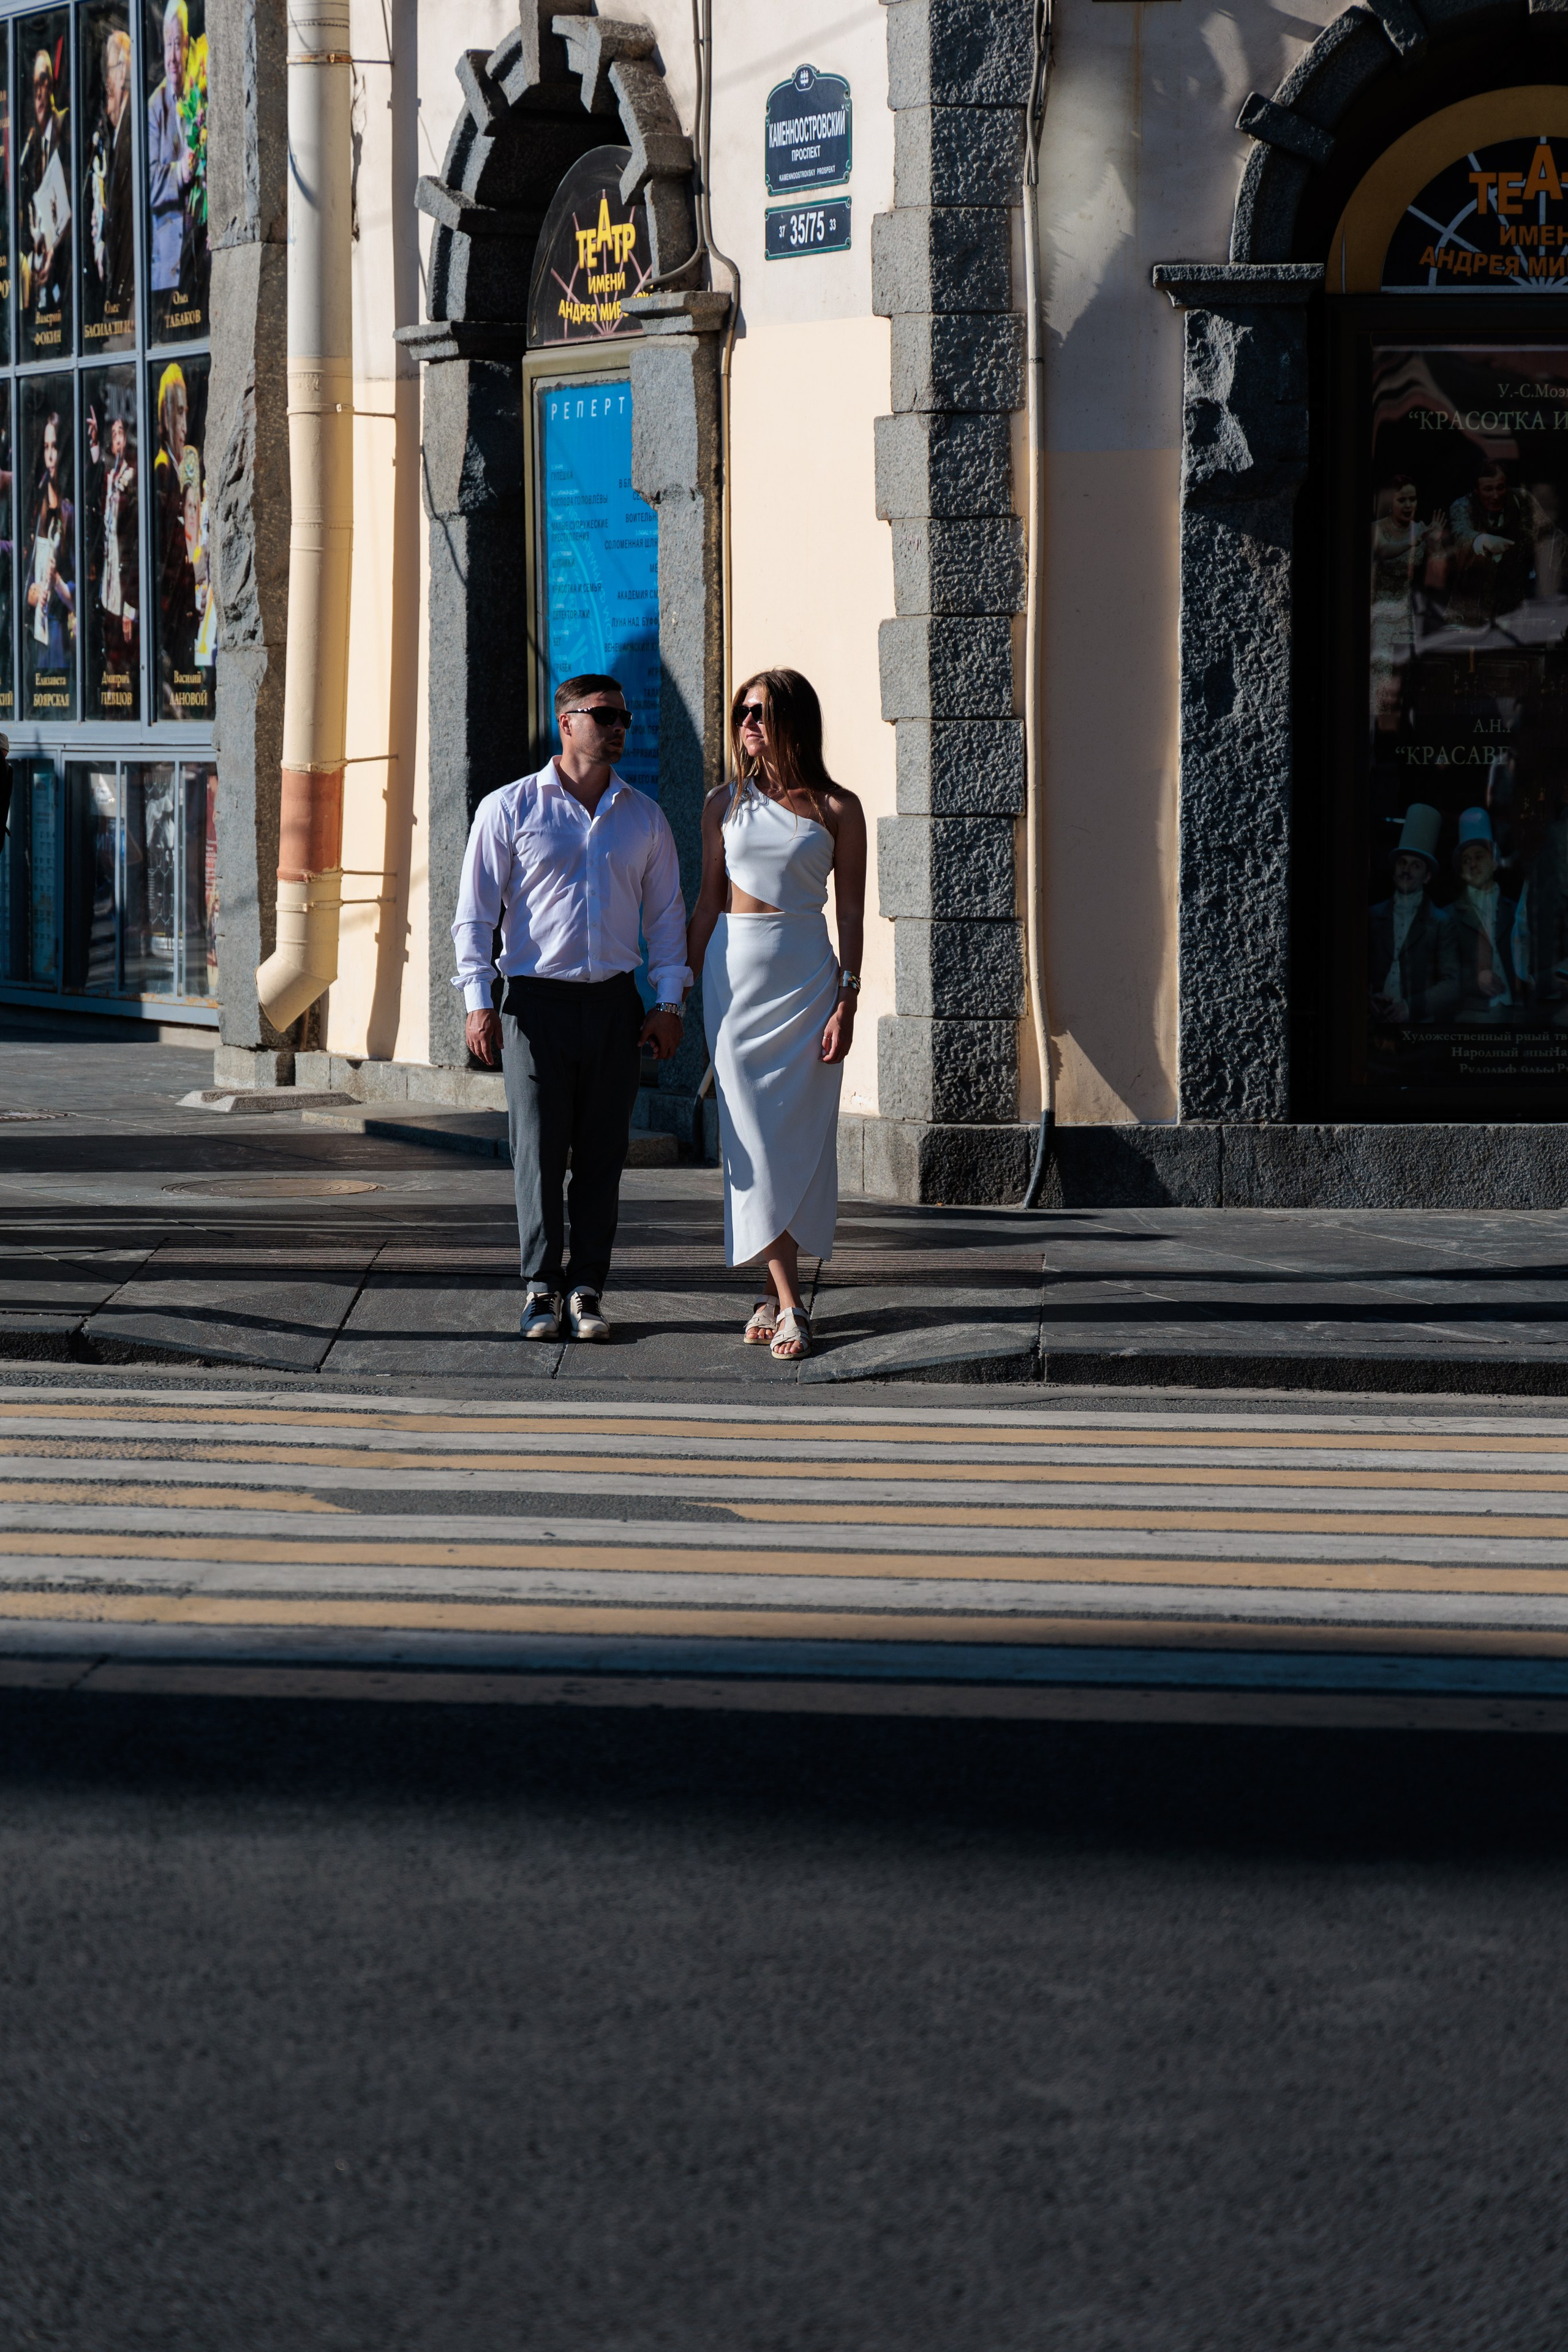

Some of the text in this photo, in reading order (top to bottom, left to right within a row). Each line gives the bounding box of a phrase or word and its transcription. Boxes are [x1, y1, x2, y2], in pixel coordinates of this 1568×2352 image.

[769, 105, 846, 148] КАМЕННООСТРОВСКИЙ
[791, 145, 821, 161] ПРОСПЕКТ
[778, 165, 835, 181] KAMENNOOSTROVSKY PROSPEKT
[1468, 143, 1568, 215] ТЕА
[575, 198, 636, 270] ТЕАТР
[778, 210, 837, 246] 37 35/75 33
[1419, 245, 1568, 277] АНДРЕЯ МИ
[587, 271, 626, 295] ИМЕНИ
[164, 309, 202, 329] ТАБАКОВ
[557, 299, 598, 325] АНДРЕЯ
[1498, 383, 1568, 398] У.-С.Моэ
[551, 396, 625, 421] РЕПЕРТ
[605, 538, 643, 550] СОЛОМЕННАЯ
[583, 582, 601, 593] СЕМЬЯ
[617, 590, 648, 601] АКАДЕМИЯ
[611, 617, 627, 627] ЛУНА
[628, 616, 639, 627] НАД
[33, 693, 70, 707] БОЯРСКАЯ
[169, 689, 208, 706] ЛАНОВОЙ
[1401, 1030, 1512, 1044] Художественный
[1450, 1046, 1519, 1060] Народный
